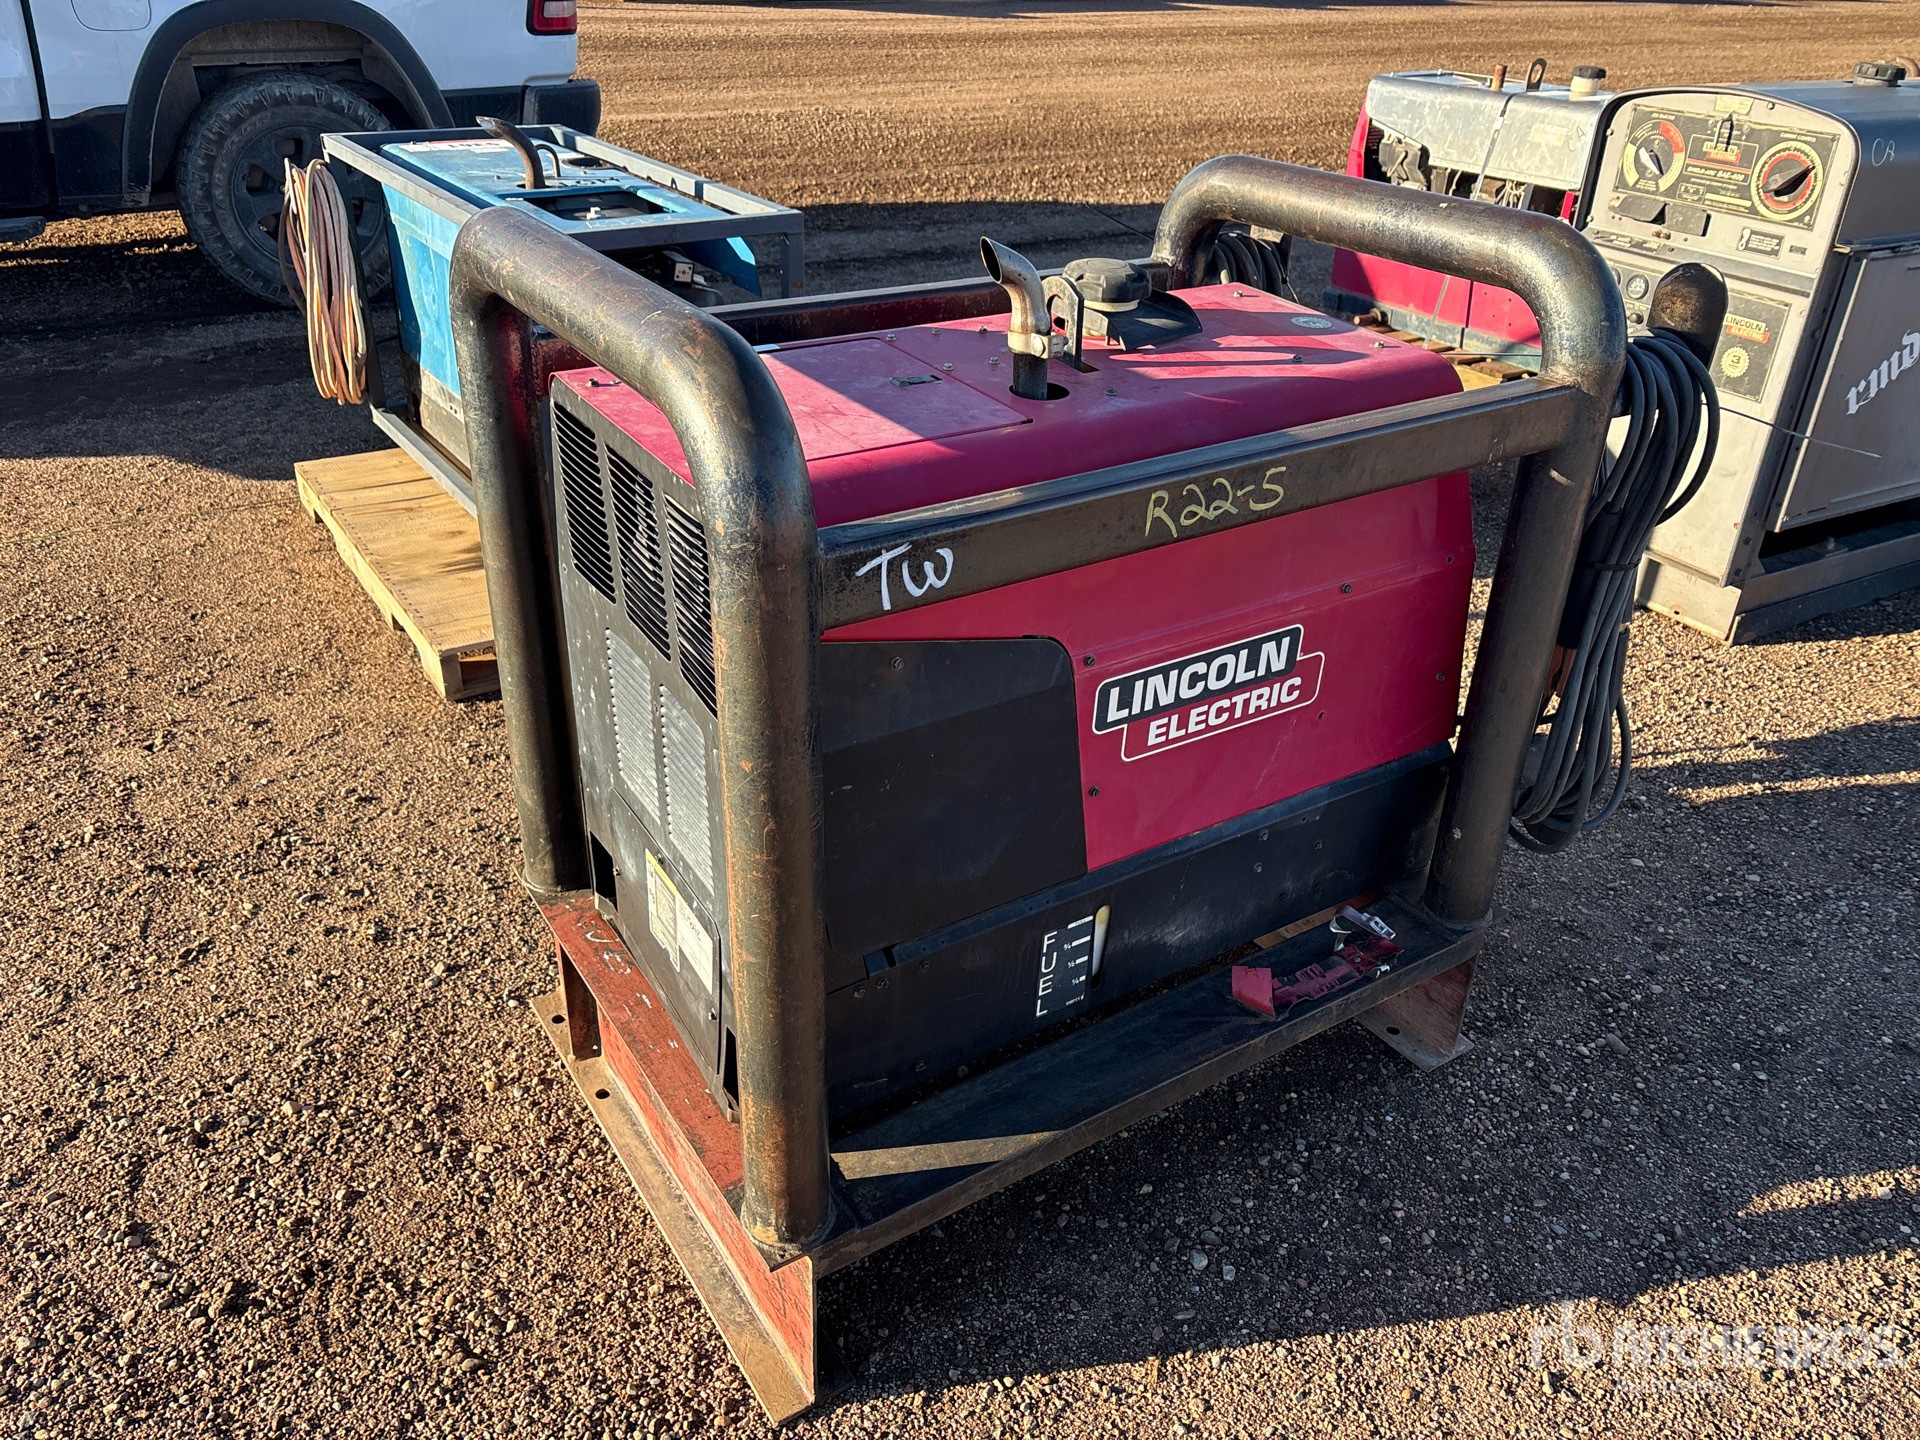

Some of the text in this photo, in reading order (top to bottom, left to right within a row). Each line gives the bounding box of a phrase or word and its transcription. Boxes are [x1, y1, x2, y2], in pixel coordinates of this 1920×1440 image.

[1725, 316, 1763, 331] LINCOLN
[1106, 636, 1291, 723] LINCOLN
[1147, 676, 1302, 746] ELECTRIC
[1036, 931, 1058, 1017] FUEL
